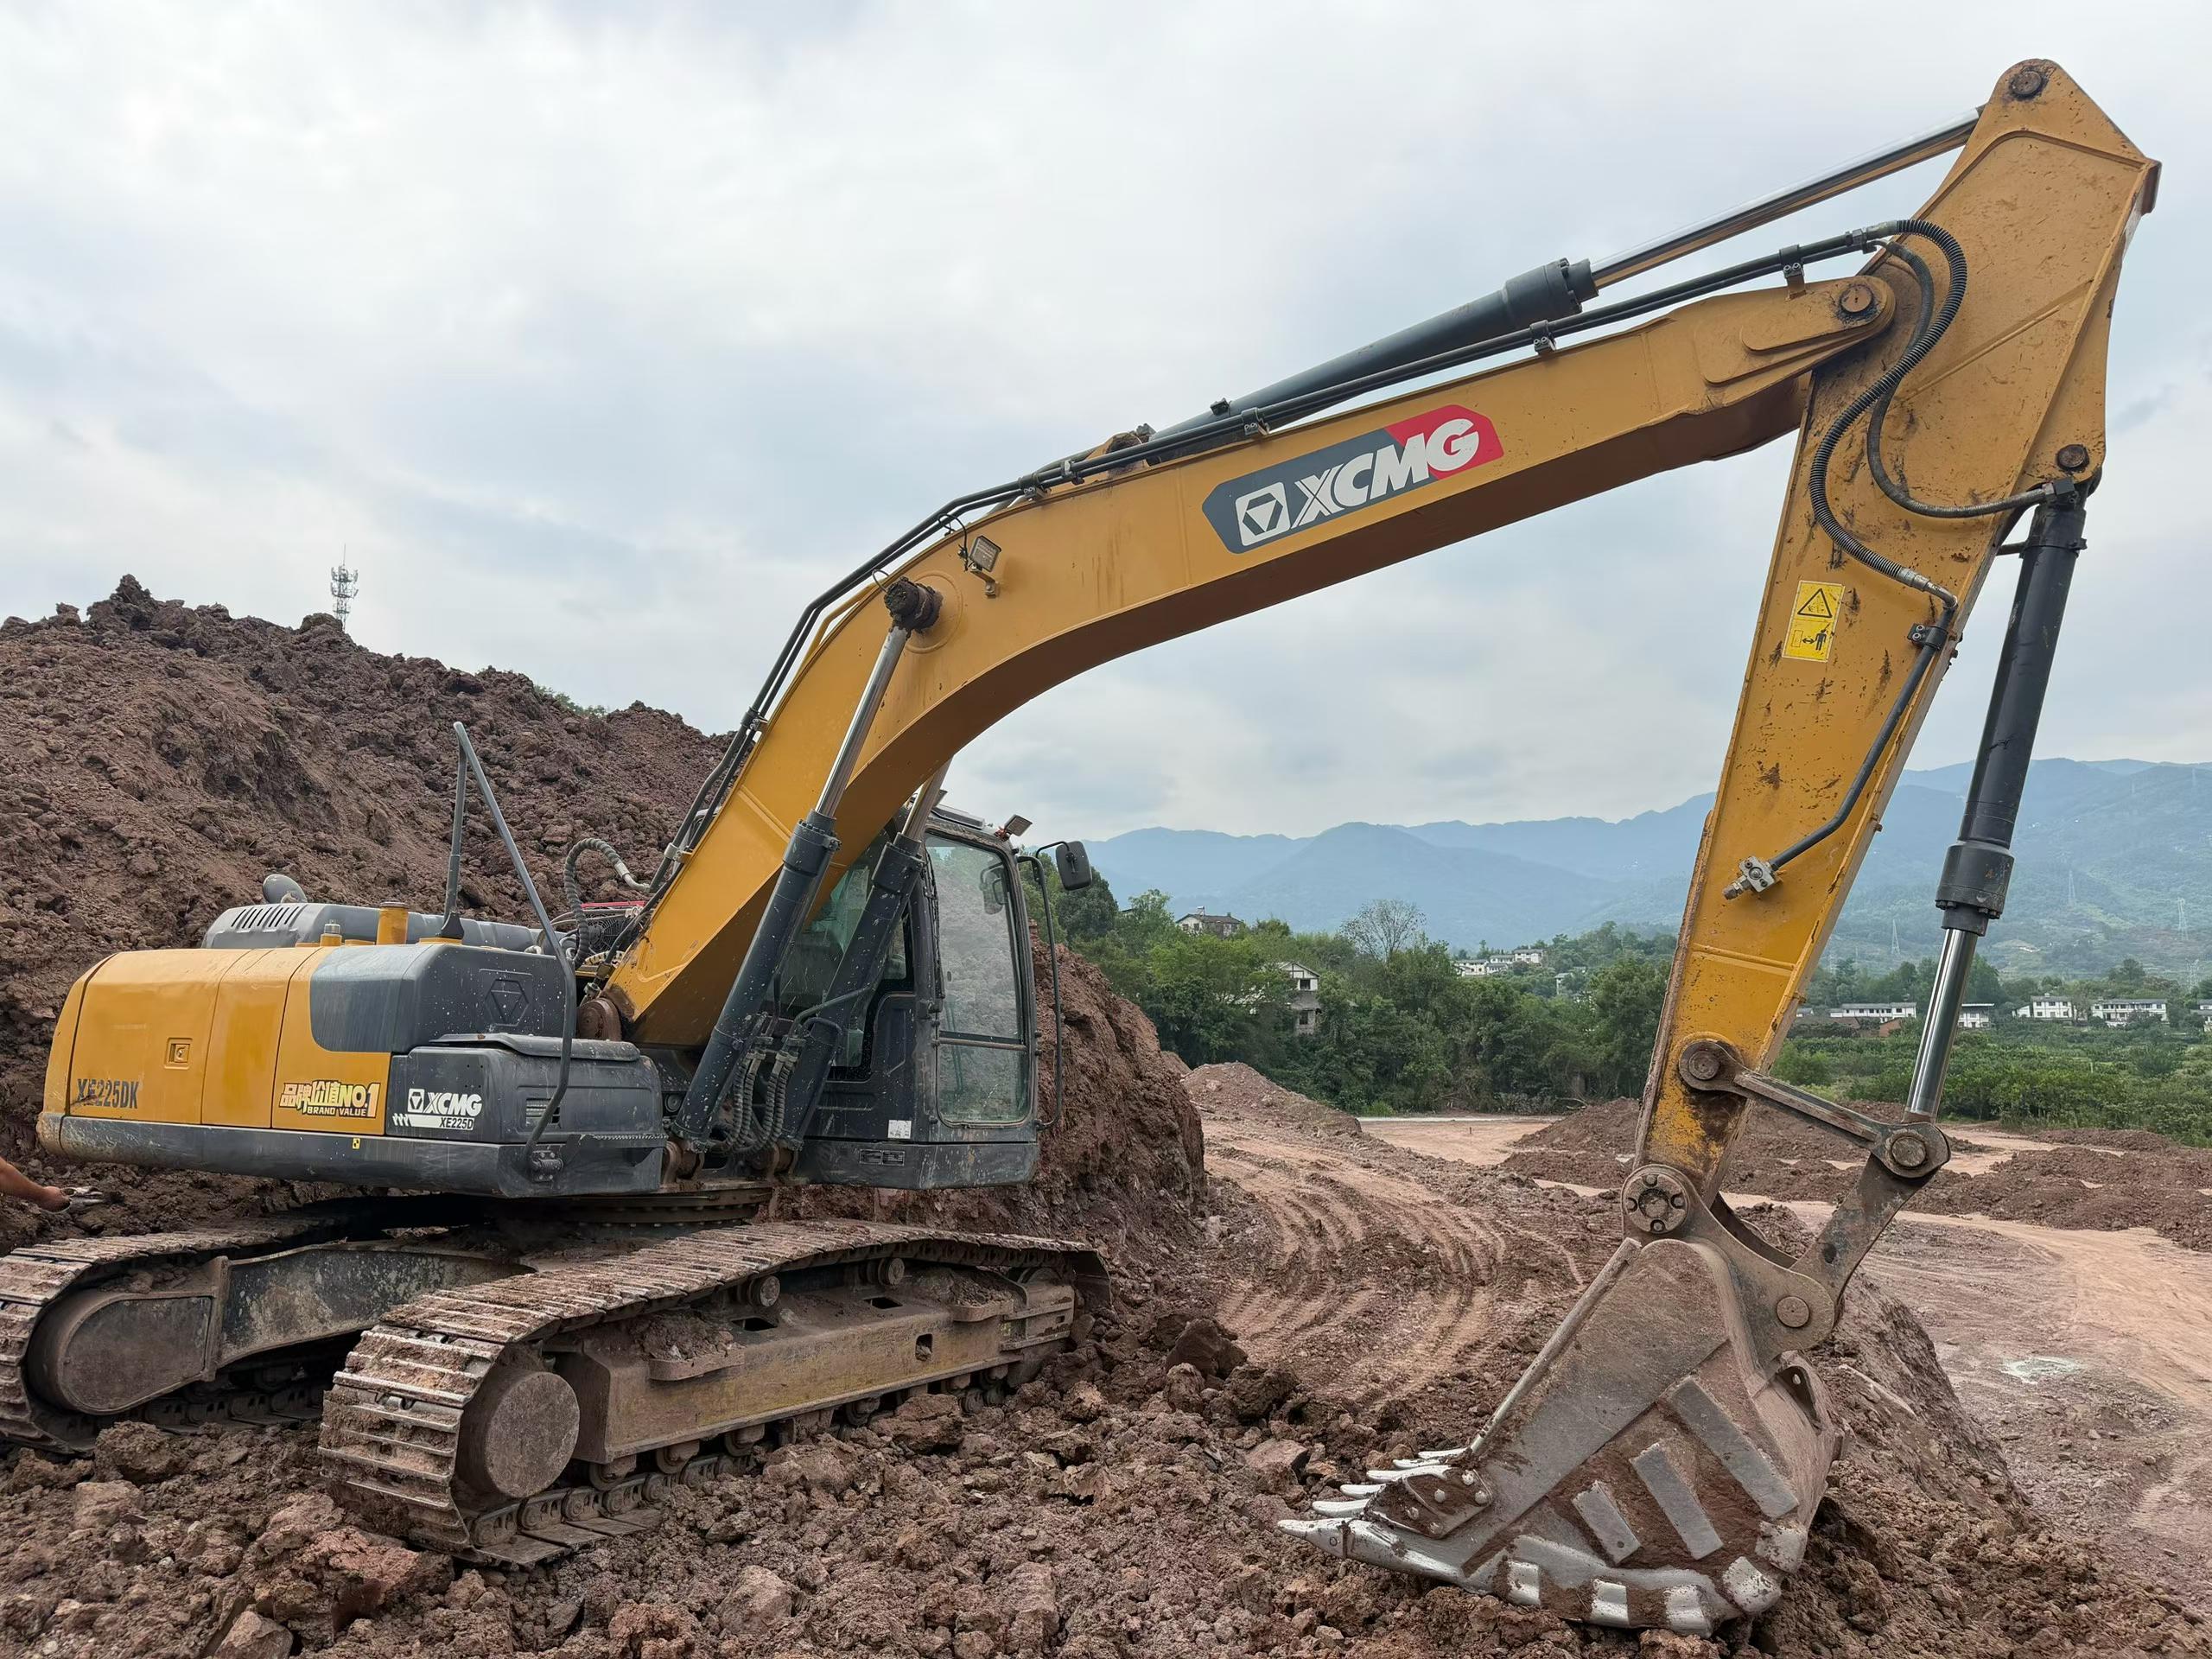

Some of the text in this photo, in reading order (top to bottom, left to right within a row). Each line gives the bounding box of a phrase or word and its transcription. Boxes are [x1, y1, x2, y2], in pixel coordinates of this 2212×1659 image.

[1290, 418, 1480, 529] XCMG
[307, 1106, 367, 1116] BRAND VALUE
[423, 1092, 483, 1116] XCMG
[439, 1116, 474, 1130] XE225D
